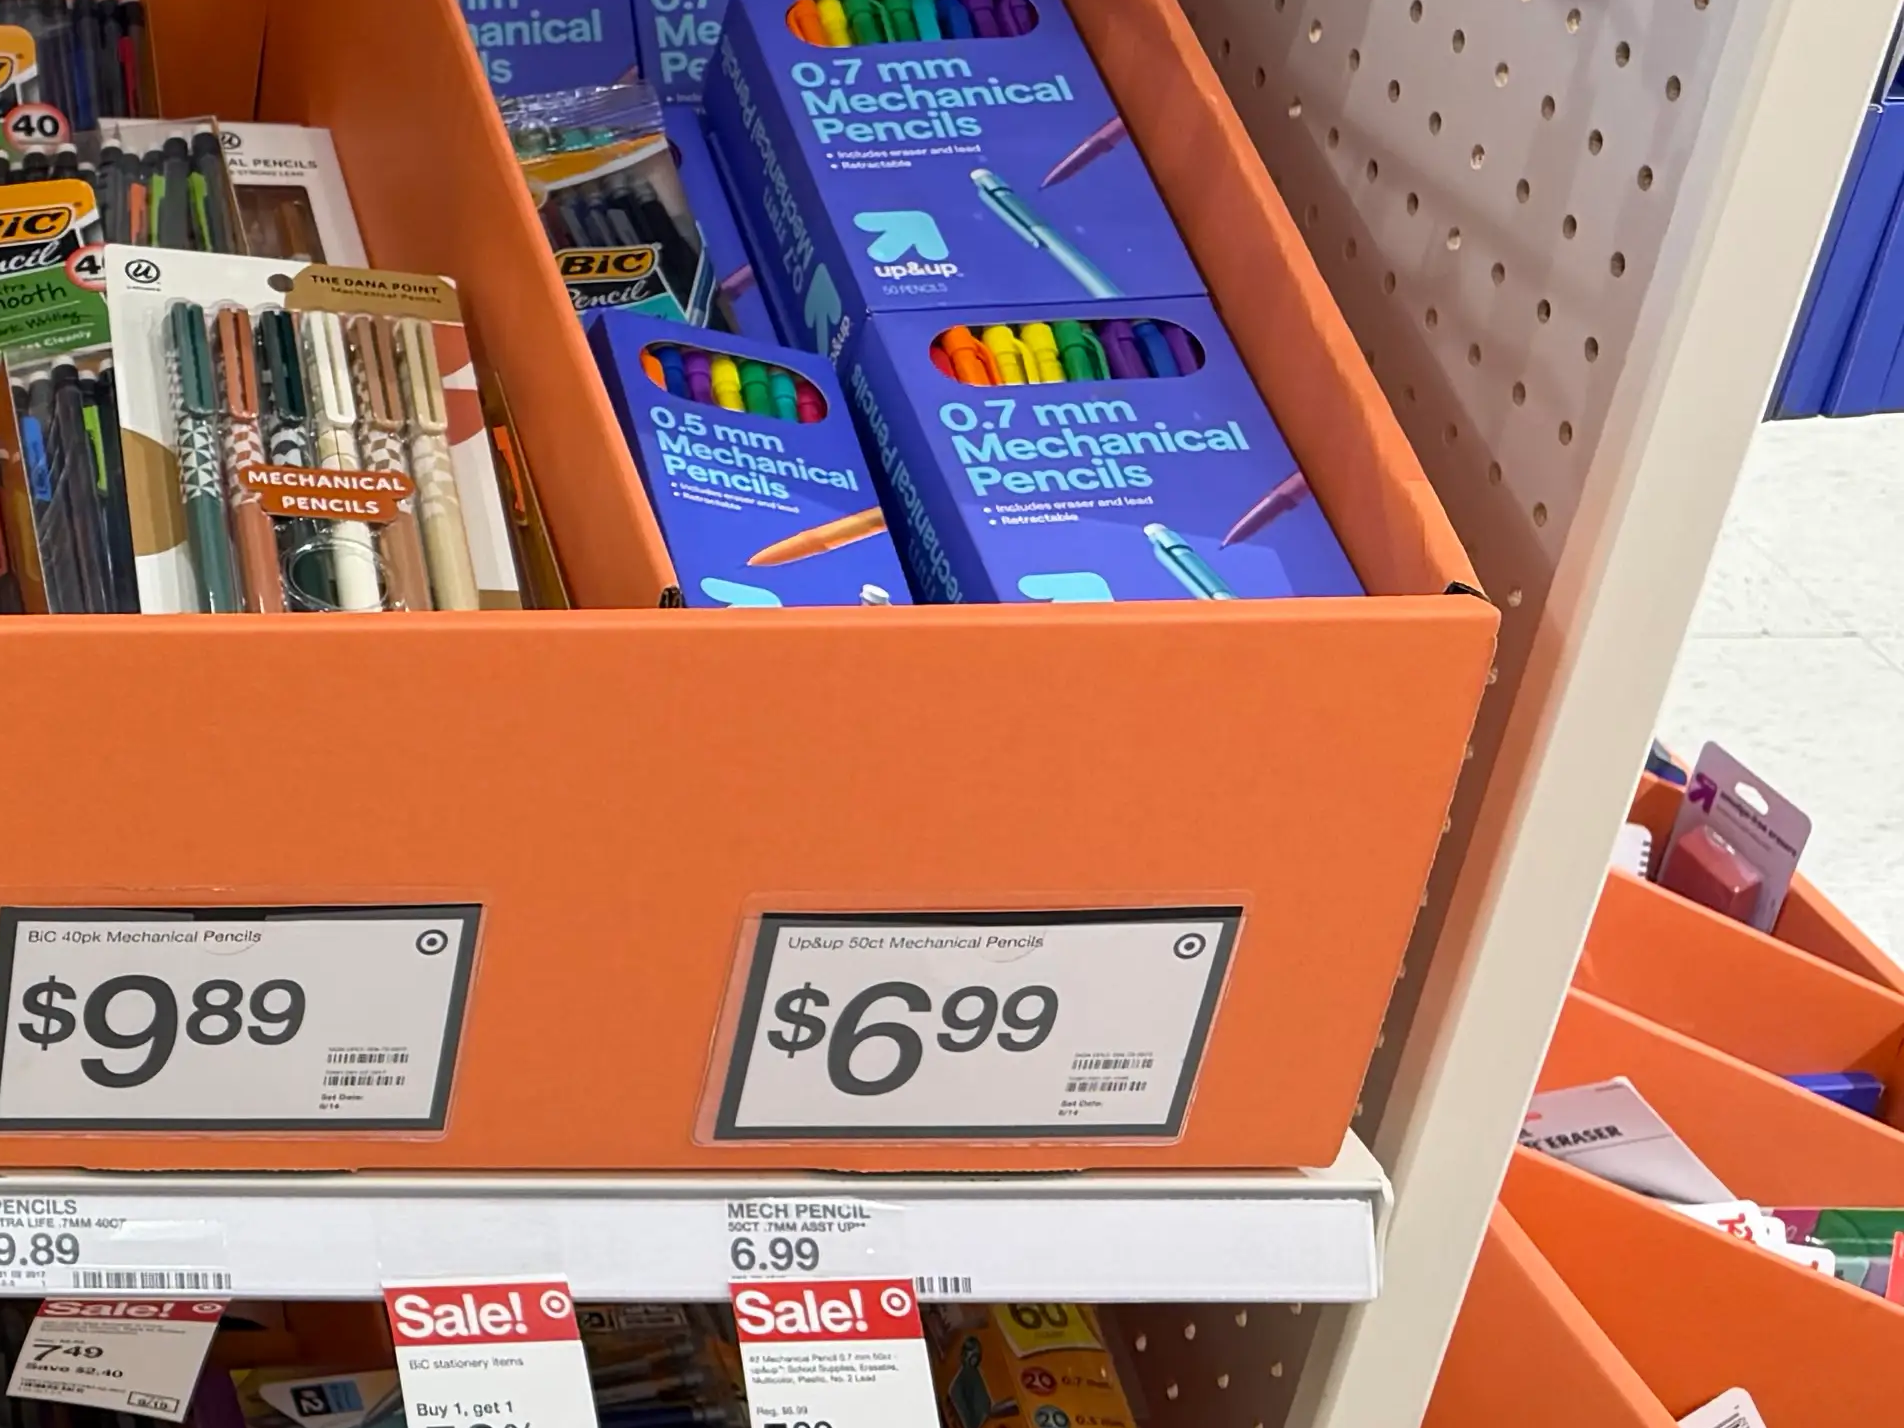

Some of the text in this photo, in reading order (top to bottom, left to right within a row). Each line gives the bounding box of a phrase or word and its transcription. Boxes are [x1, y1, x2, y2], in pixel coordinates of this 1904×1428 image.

[791, 57, 973, 88] 0.7 mm
[800, 74, 1074, 118] Mechanical
[811, 110, 983, 144] Pencils
[873, 261, 958, 280] up&up
[311, 274, 439, 295] THE DANA POINT
[248, 470, 406, 491] MECHANICAL
[281, 495, 380, 515] PENCILS
[730, 1236, 820, 1272] 6.99
